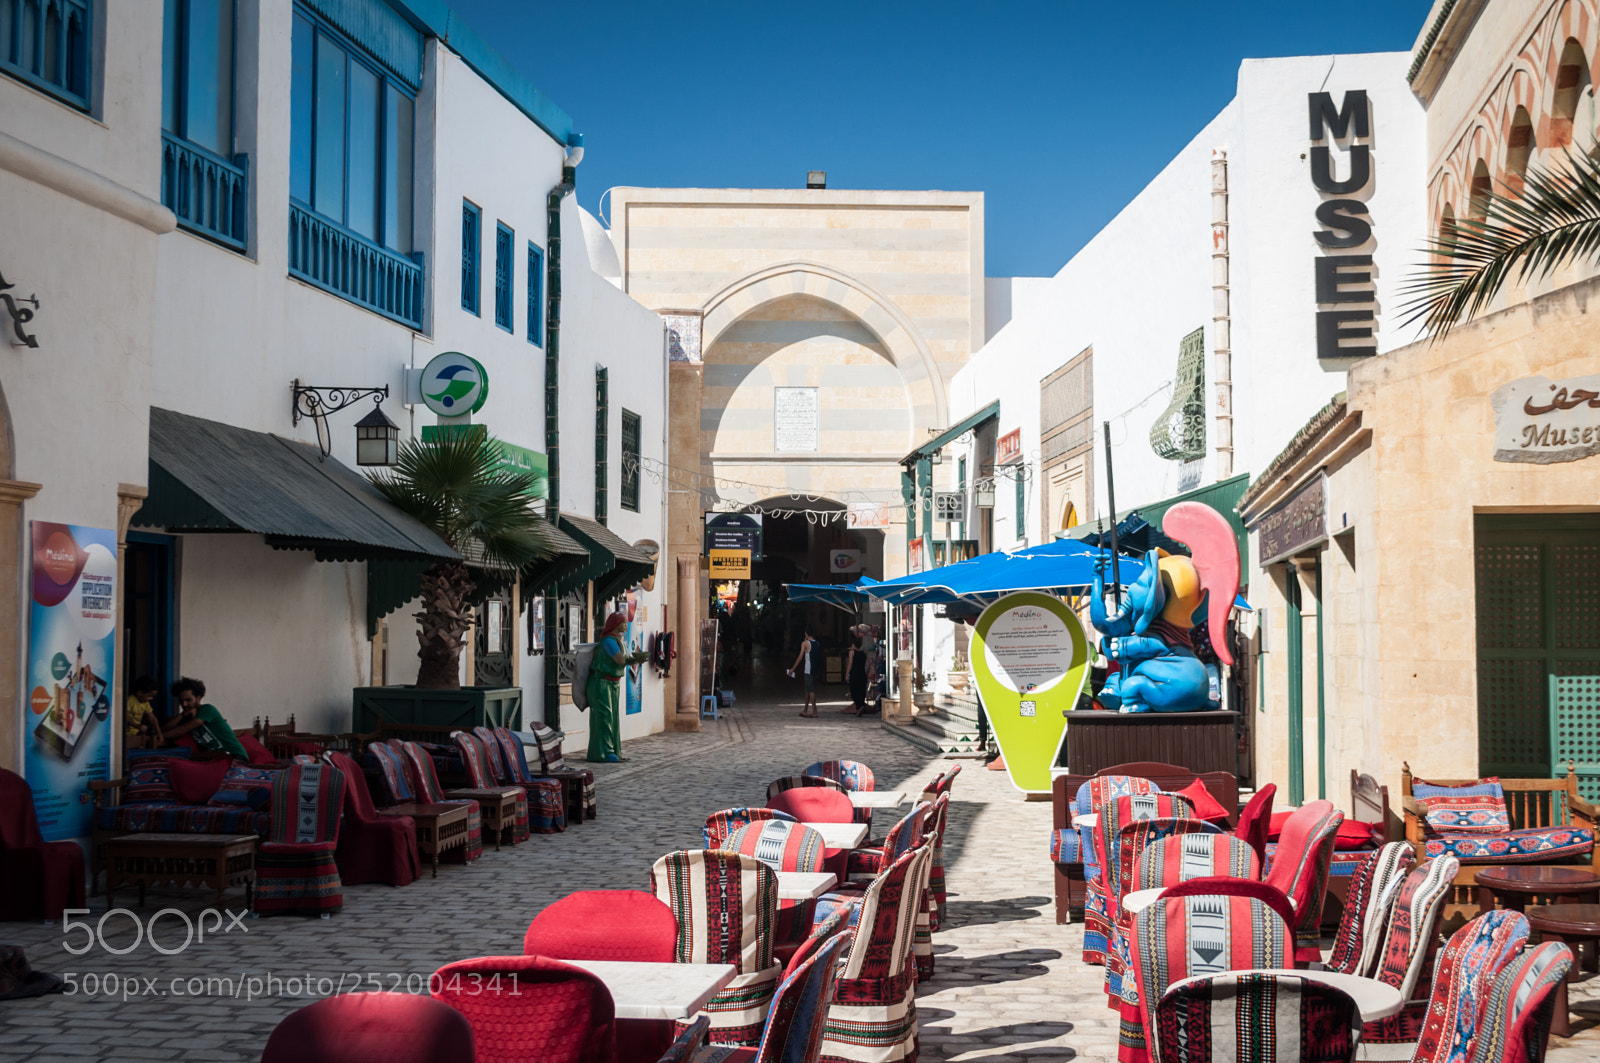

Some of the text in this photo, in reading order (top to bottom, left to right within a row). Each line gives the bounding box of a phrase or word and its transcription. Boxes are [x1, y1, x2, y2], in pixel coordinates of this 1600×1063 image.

[1308, 90, 1376, 359] MUSEE
[1523, 384, 1600, 416] حف
[82, 582, 112, 596] APPLICATION
[81, 596, 112, 611] INTERACTIVE
